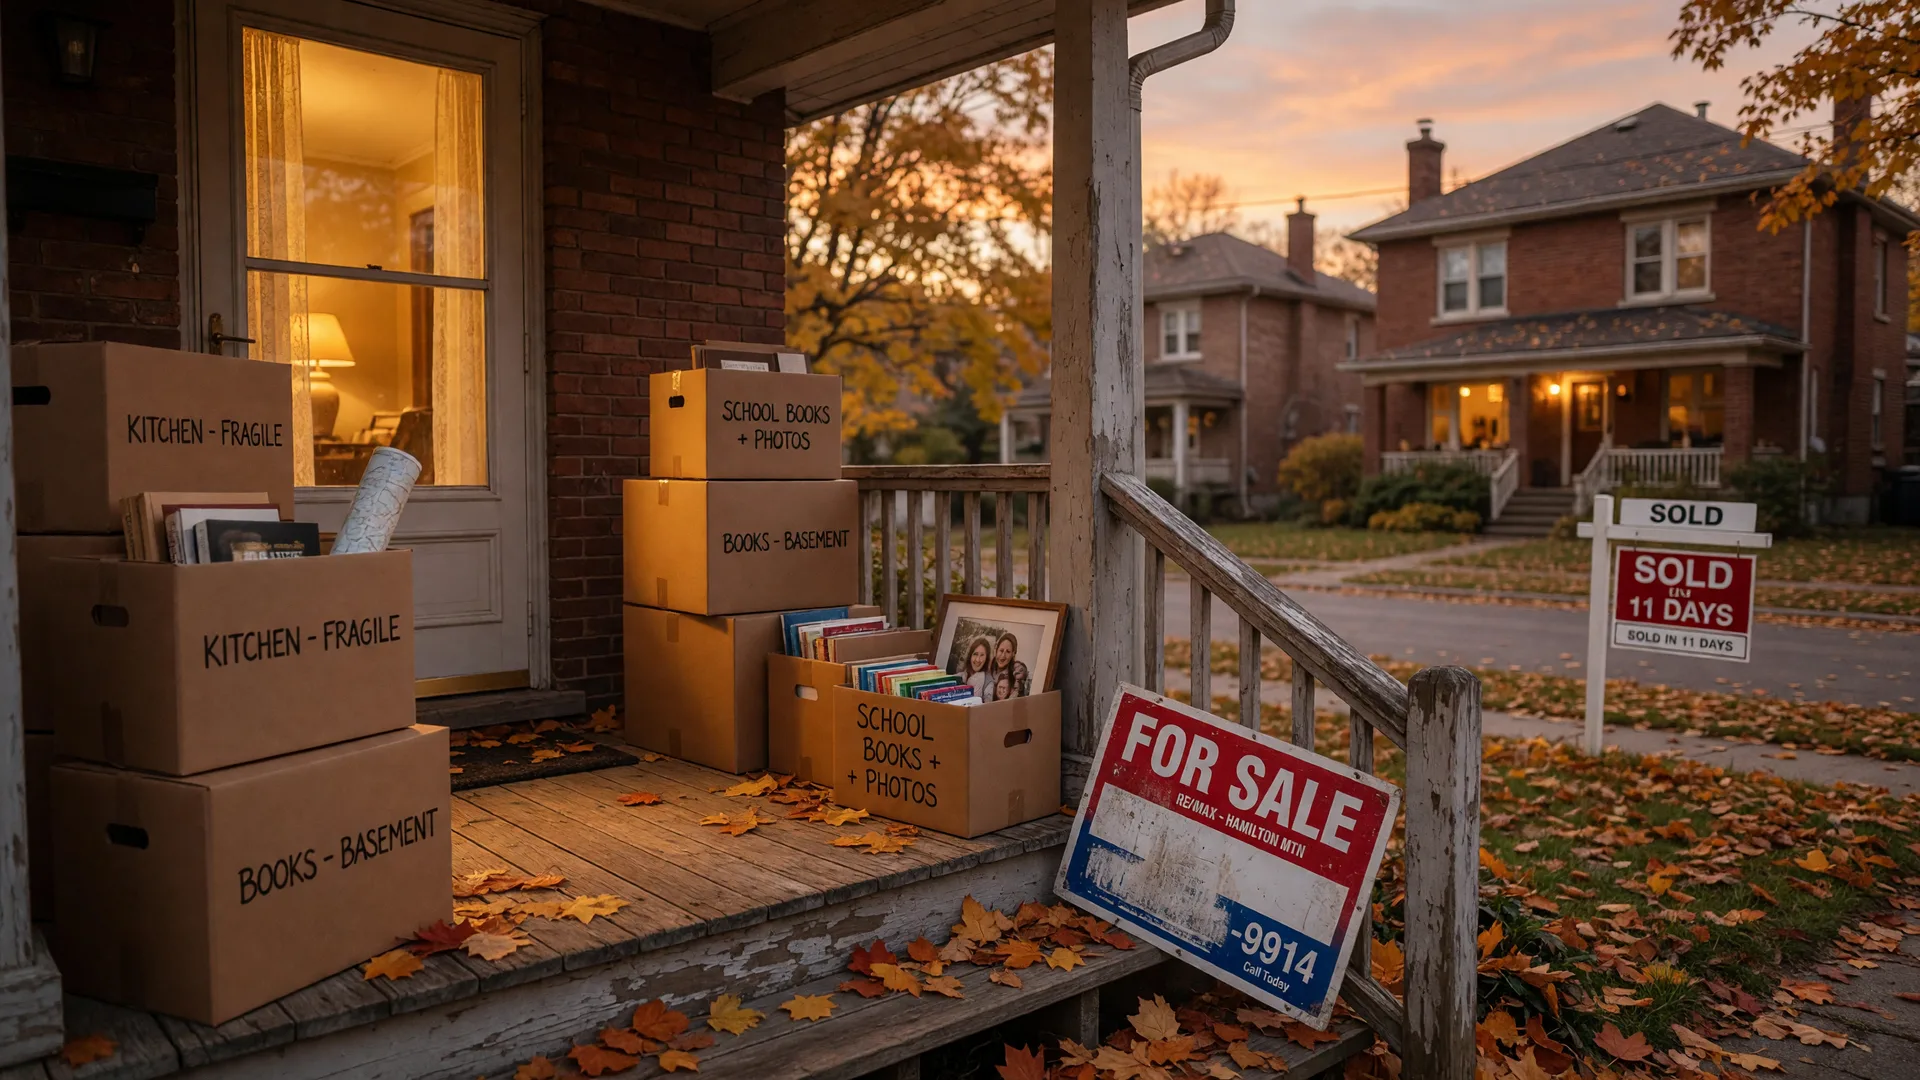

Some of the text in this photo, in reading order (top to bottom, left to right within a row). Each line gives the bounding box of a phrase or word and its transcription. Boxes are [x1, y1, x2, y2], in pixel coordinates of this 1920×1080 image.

[722, 400, 829, 424] SCHOOL BOOKS
[127, 414, 203, 444] KITCHEN
[221, 420, 283, 447] FRAGILE
[738, 429, 810, 449] + PHOTOS
[1650, 503, 1723, 526] SOLD
[723, 531, 769, 553] BOOKS
[784, 529, 849, 550] BASEMENT
[1634, 555, 1733, 590] SOLD
[1629, 596, 1733, 627] 11 DAYS
[204, 625, 300, 669] KITCHEN
[323, 614, 401, 651] FRAGILE
[1628, 630, 1733, 652] SOLD IN 11 DAYS
[857, 703, 934, 741] SCHOOL
[863, 737, 940, 771] BOOKS +
[847, 769, 938, 807] + PHOTOS
[1121, 711, 1363, 854] FOR SALE
[1175, 793, 1218, 821] RE/MAX
[1225, 813, 1280, 847] HAMILTON
[1280, 837, 1306, 859] MTN
[238, 807, 438, 905] BOOKS - BASEMENT
[1231, 922, 1318, 984] -9914
[1243, 961, 1290, 993] Call Today
